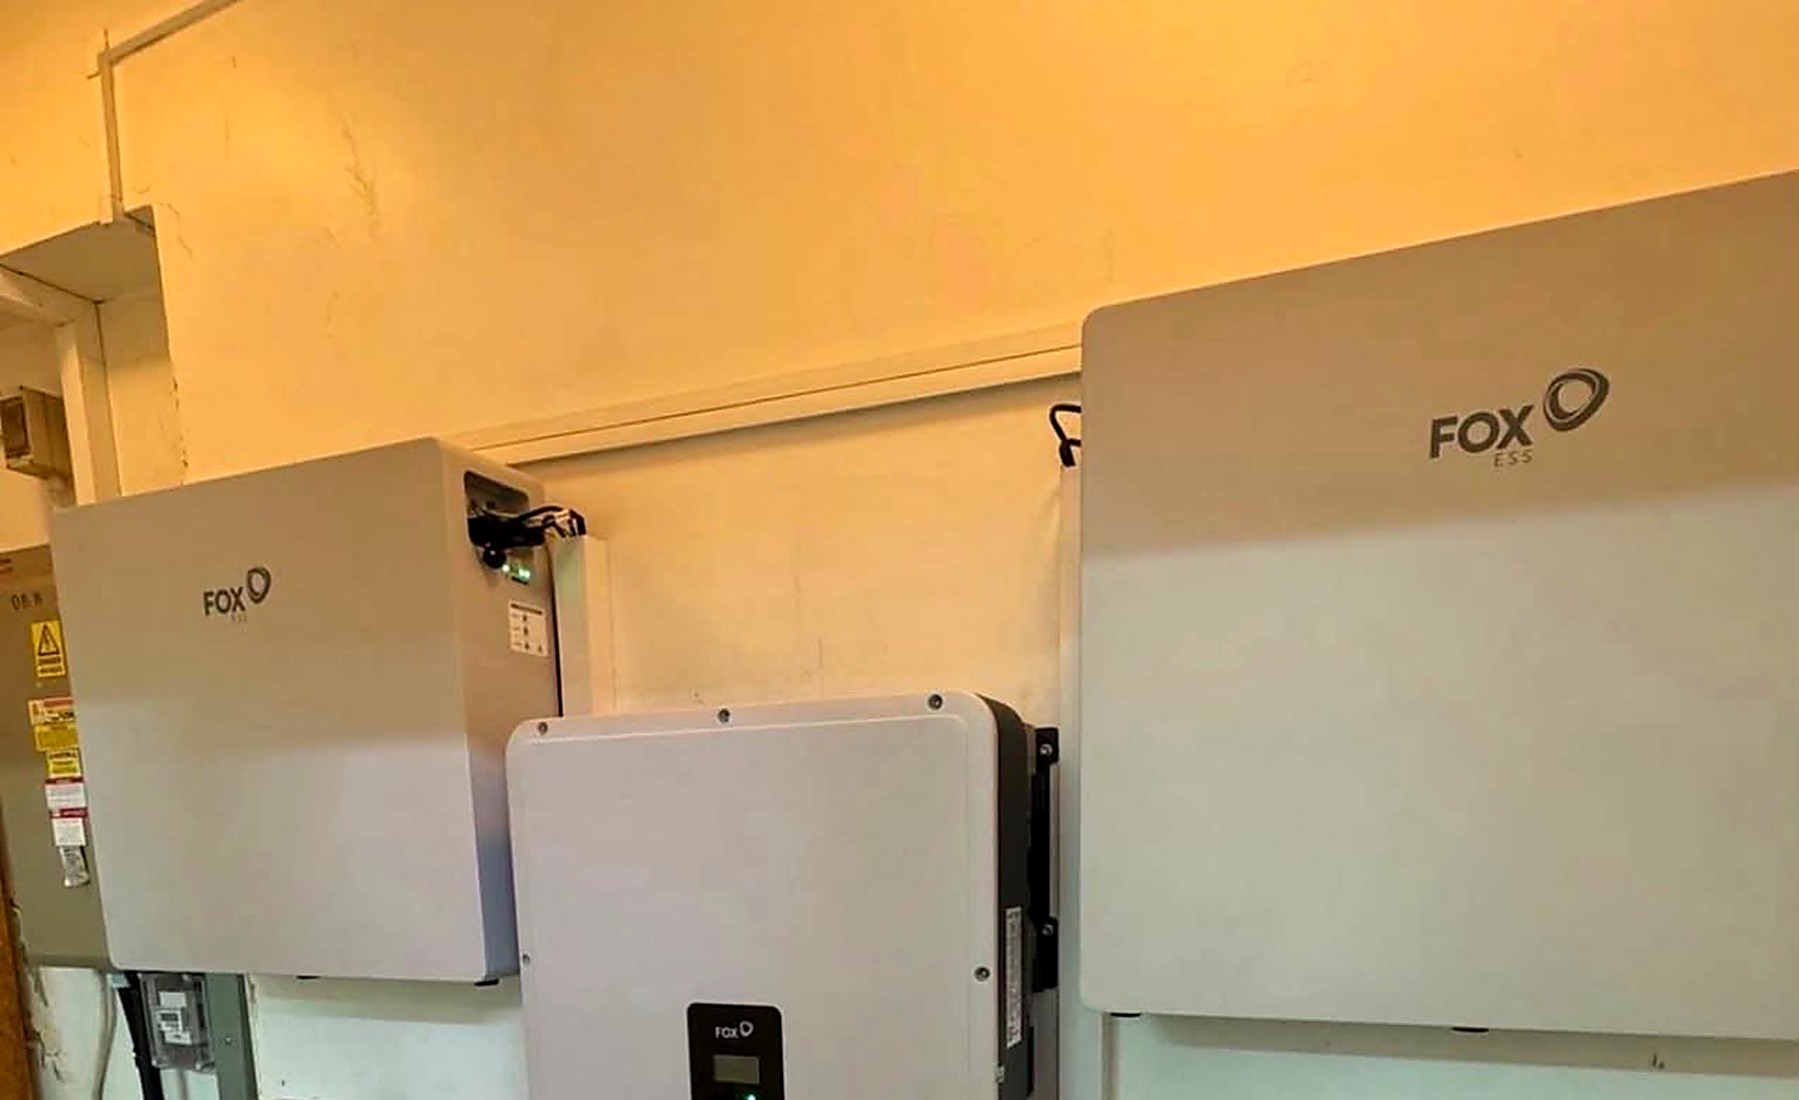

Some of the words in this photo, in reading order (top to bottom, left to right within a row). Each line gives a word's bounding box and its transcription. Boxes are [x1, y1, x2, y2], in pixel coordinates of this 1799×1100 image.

[1430, 405, 1534, 459] FOX
[1493, 451, 1533, 468] ESS
[203, 586, 246, 616] FOX
[715, 1026, 739, 1038] FOX
